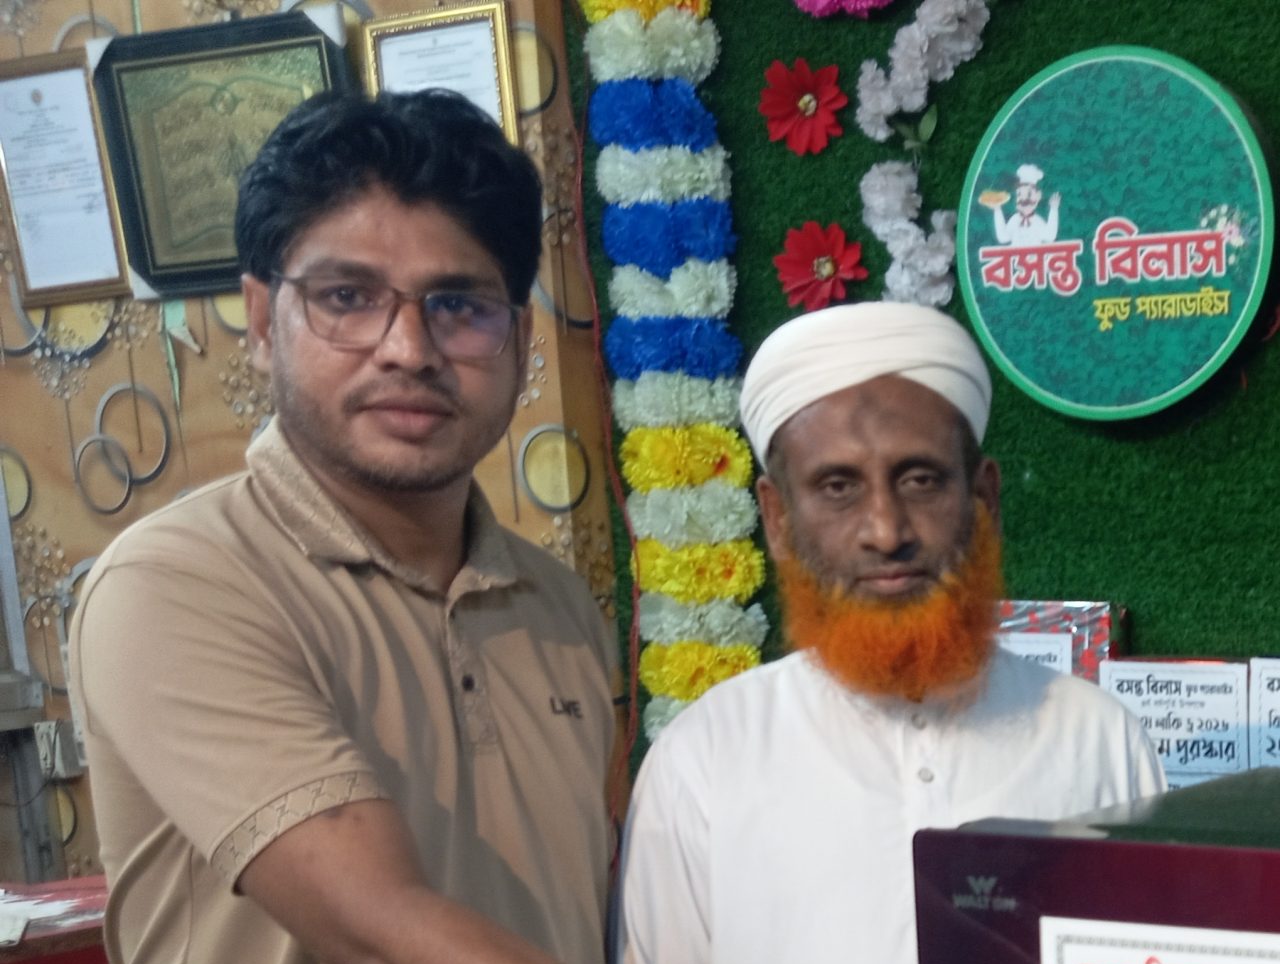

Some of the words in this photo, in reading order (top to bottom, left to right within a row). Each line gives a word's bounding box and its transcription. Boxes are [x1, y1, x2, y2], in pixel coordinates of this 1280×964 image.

[979, 239, 1083, 294] বসন্ত
[1094, 217, 1226, 286] বিলাস
[1093, 296, 1131, 332] ফুড
[1136, 285, 1231, 322] প্যারাডাইস
[1116, 678, 1144, 697] বসন্ত
[1146, 674, 1182, 696] বিলাস
[1176, 738, 1236, 765] পুরস্কার
